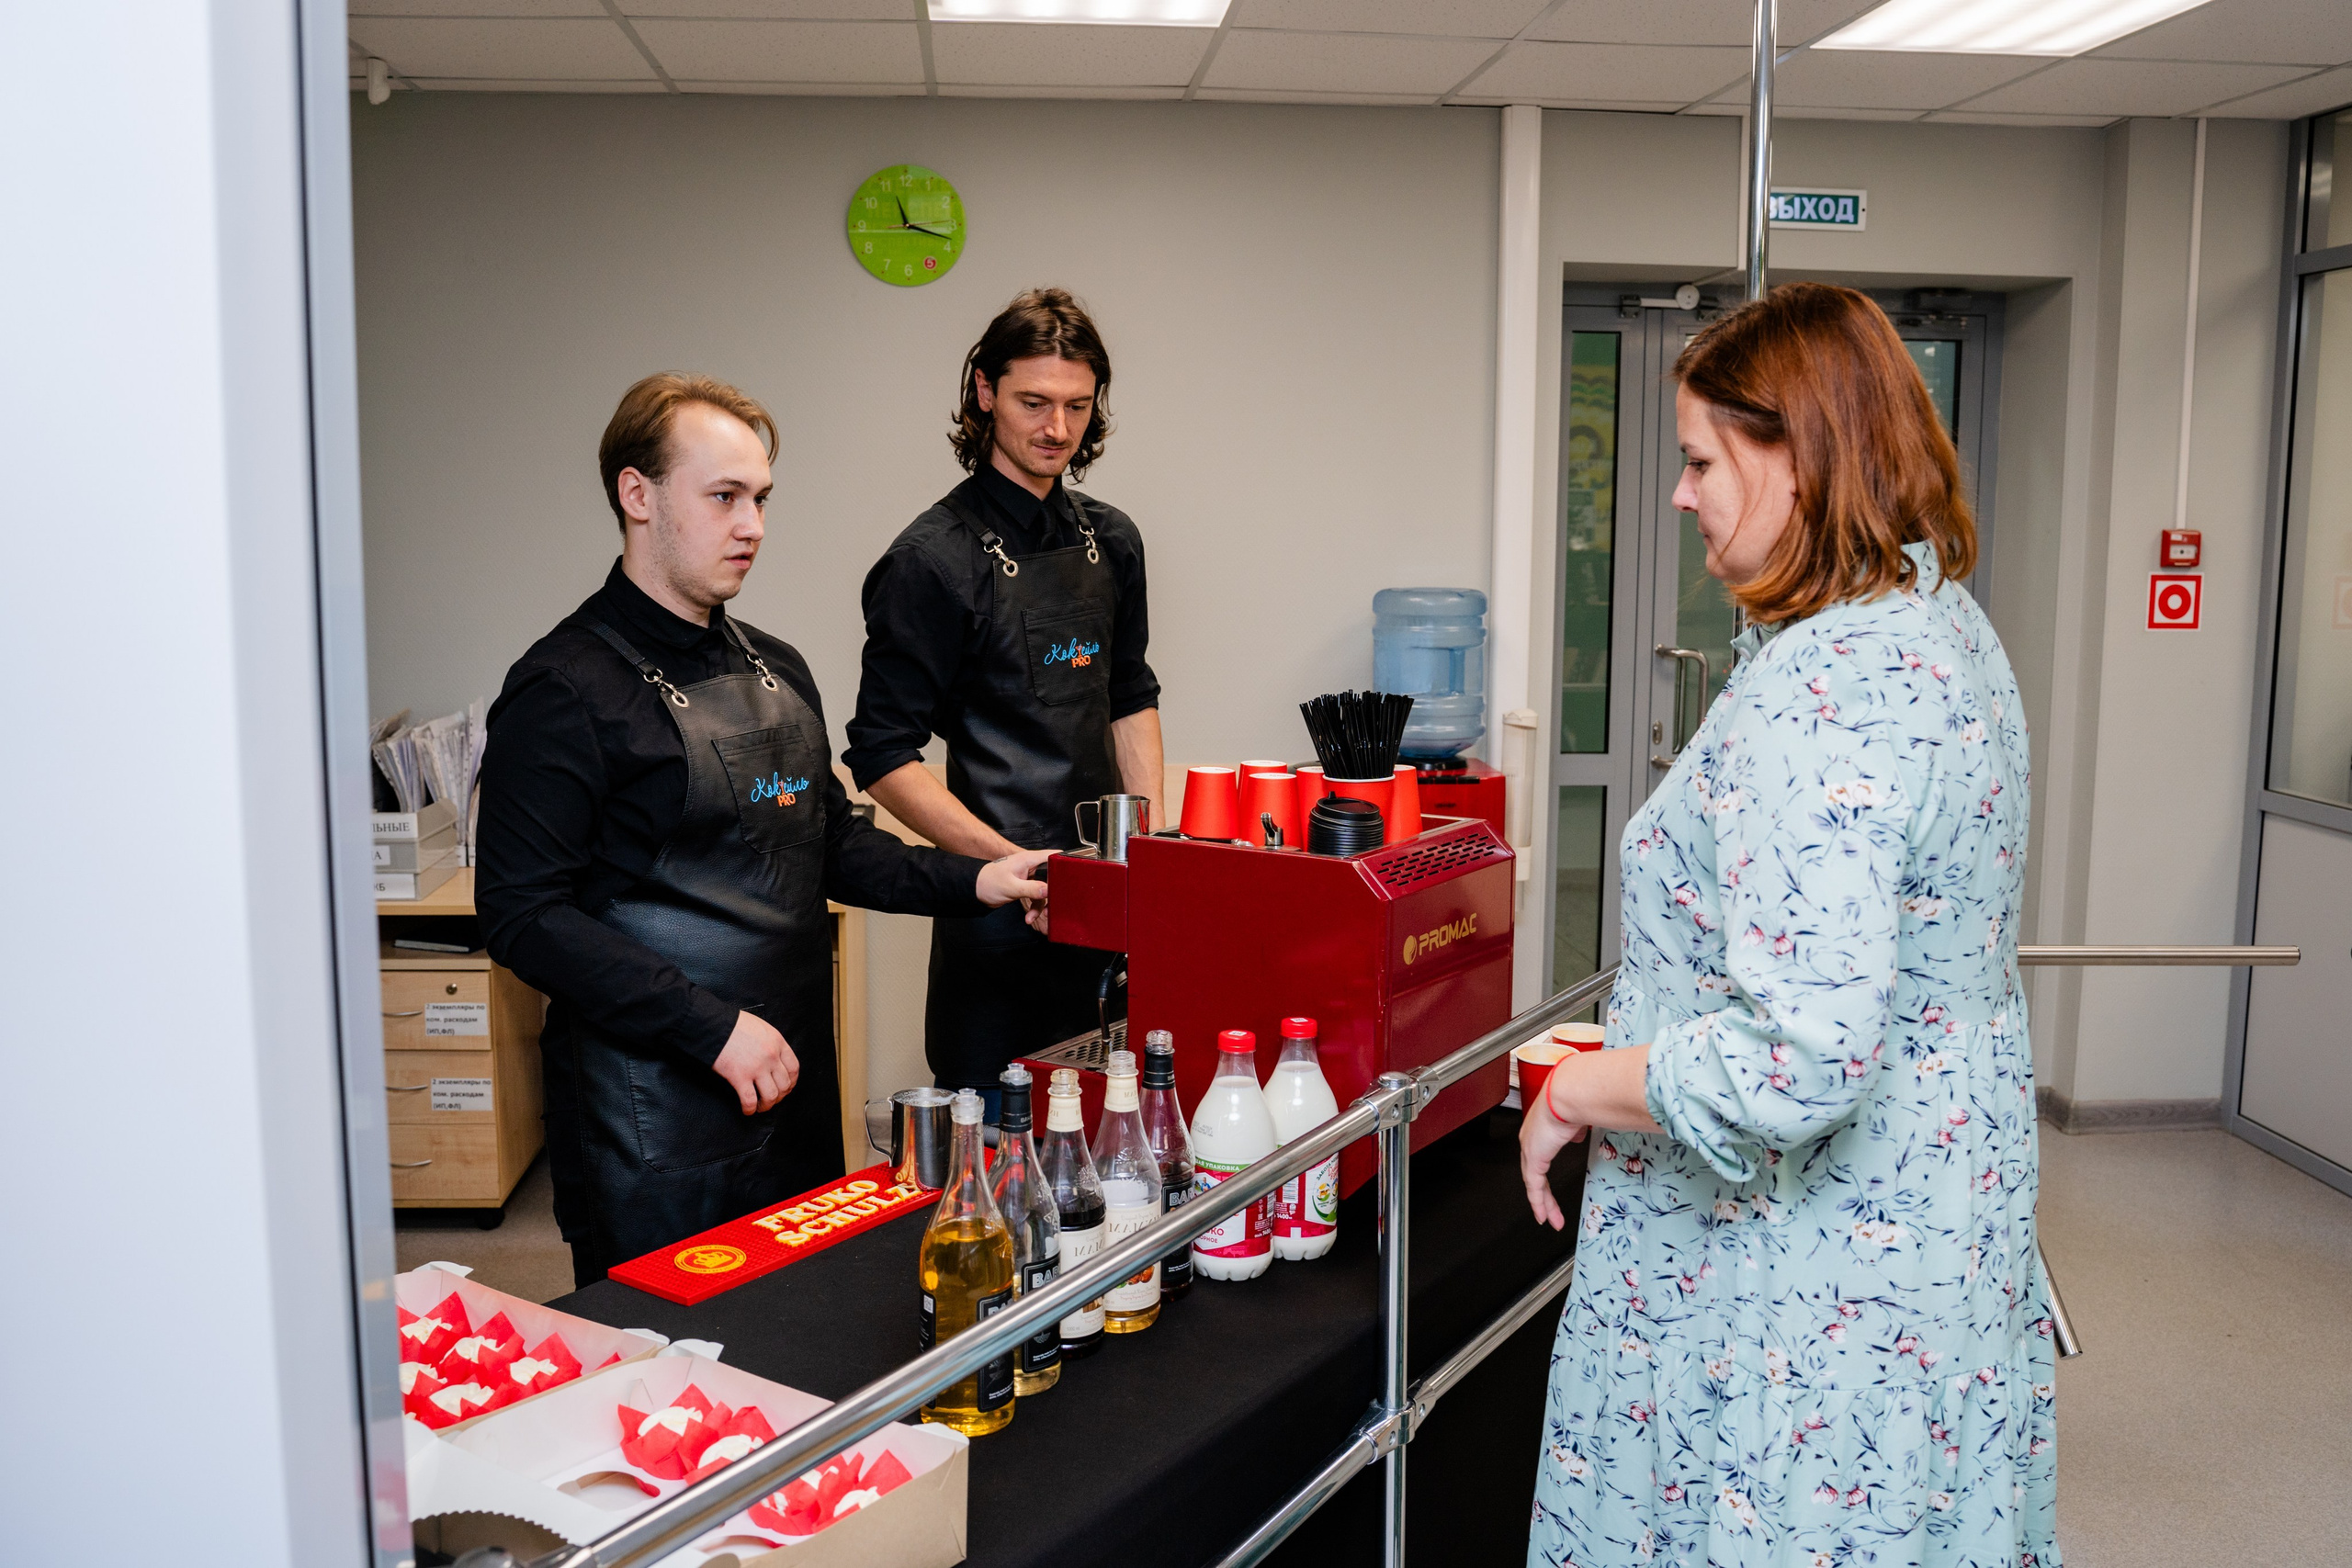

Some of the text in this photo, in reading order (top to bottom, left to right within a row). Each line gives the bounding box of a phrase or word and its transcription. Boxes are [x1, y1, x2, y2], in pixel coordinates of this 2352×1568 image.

[881, 180, 891, 192] 11
[899, 175, 912, 187] 12
[865, 197, 877, 209] 10
[942, 196, 950, 209] 2
[858, 220, 866, 232] 9
[949, 219, 956, 231] 3
[865, 242, 873, 254] 8
[944, 241, 951, 253] 4
[884, 259, 891, 270] 7
[904, 265, 912, 276] 6
[1070, 655, 1091, 669] PRO
[776, 793, 797, 807] PRO
[1419, 912, 1477, 956] PROMAC
[1205, 1162, 1240, 1171] УПАКОВКА
[1316, 1162, 1331, 1181] ЗАБОТА
[752, 1179, 879, 1233] FRUKO
[775, 1182, 923, 1247] SCHULZ
